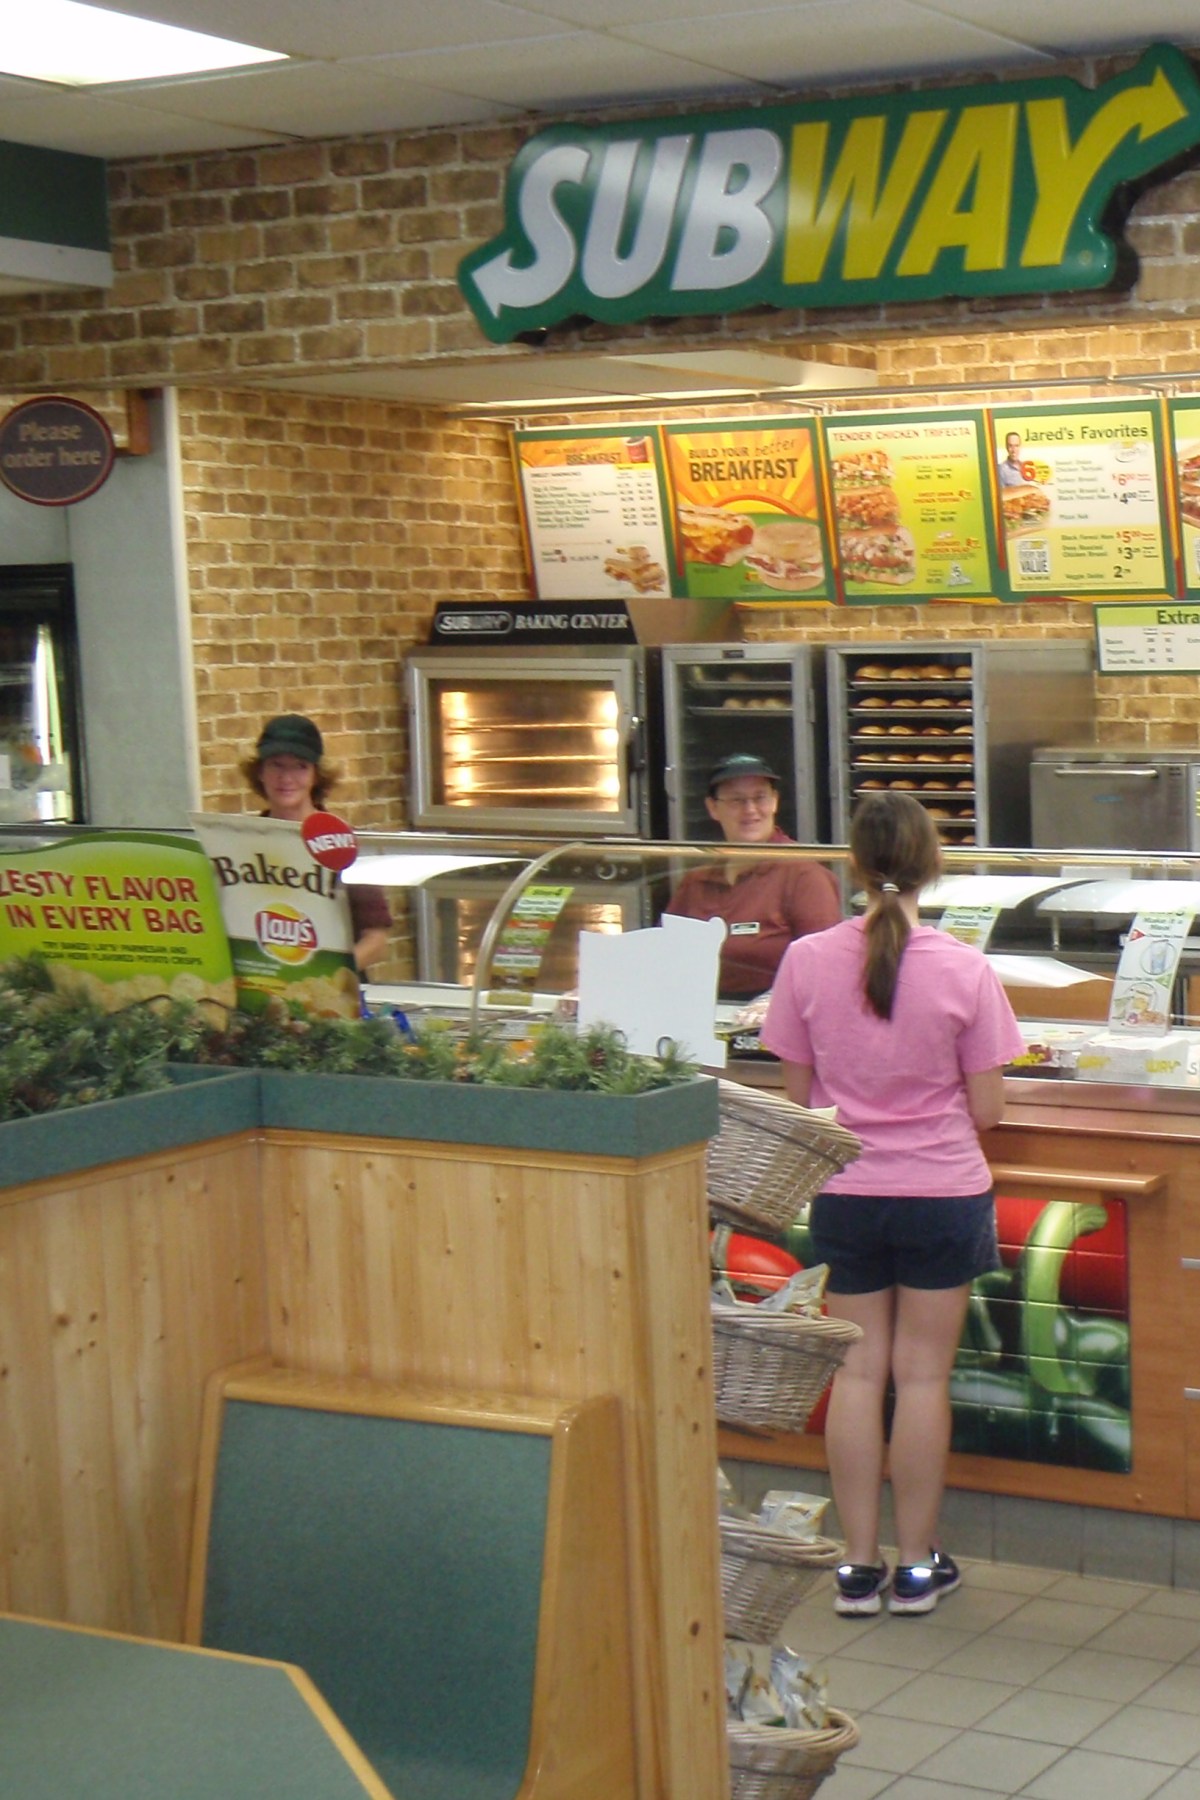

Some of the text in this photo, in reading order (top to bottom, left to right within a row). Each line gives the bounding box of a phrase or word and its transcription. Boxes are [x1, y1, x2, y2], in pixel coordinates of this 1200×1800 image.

[471, 66, 1188, 319] SUBWAY
[19, 422, 81, 441] Please
[834, 428, 971, 441] TENDER CHICKEN TRIFECTA
[1025, 425, 1148, 442] Jared's Favorites
[58, 446, 101, 465] here
[690, 448, 718, 458] BUILD
[722, 447, 748, 457] YOUR
[690, 458, 798, 482] BREAKFAST
[1021, 461, 1036, 481] 6
[1020, 560, 1049, 573] VALUE
[515, 614, 569, 629] BAKING
[570, 613, 629, 629] CENTER
[306, 833, 357, 854] NEW!
[211, 853, 338, 900] Baked!
[83, 876, 198, 902] FLAVOR
[5, 904, 205, 934] IN EVERY BAG
[260, 911, 313, 947] Lay's
